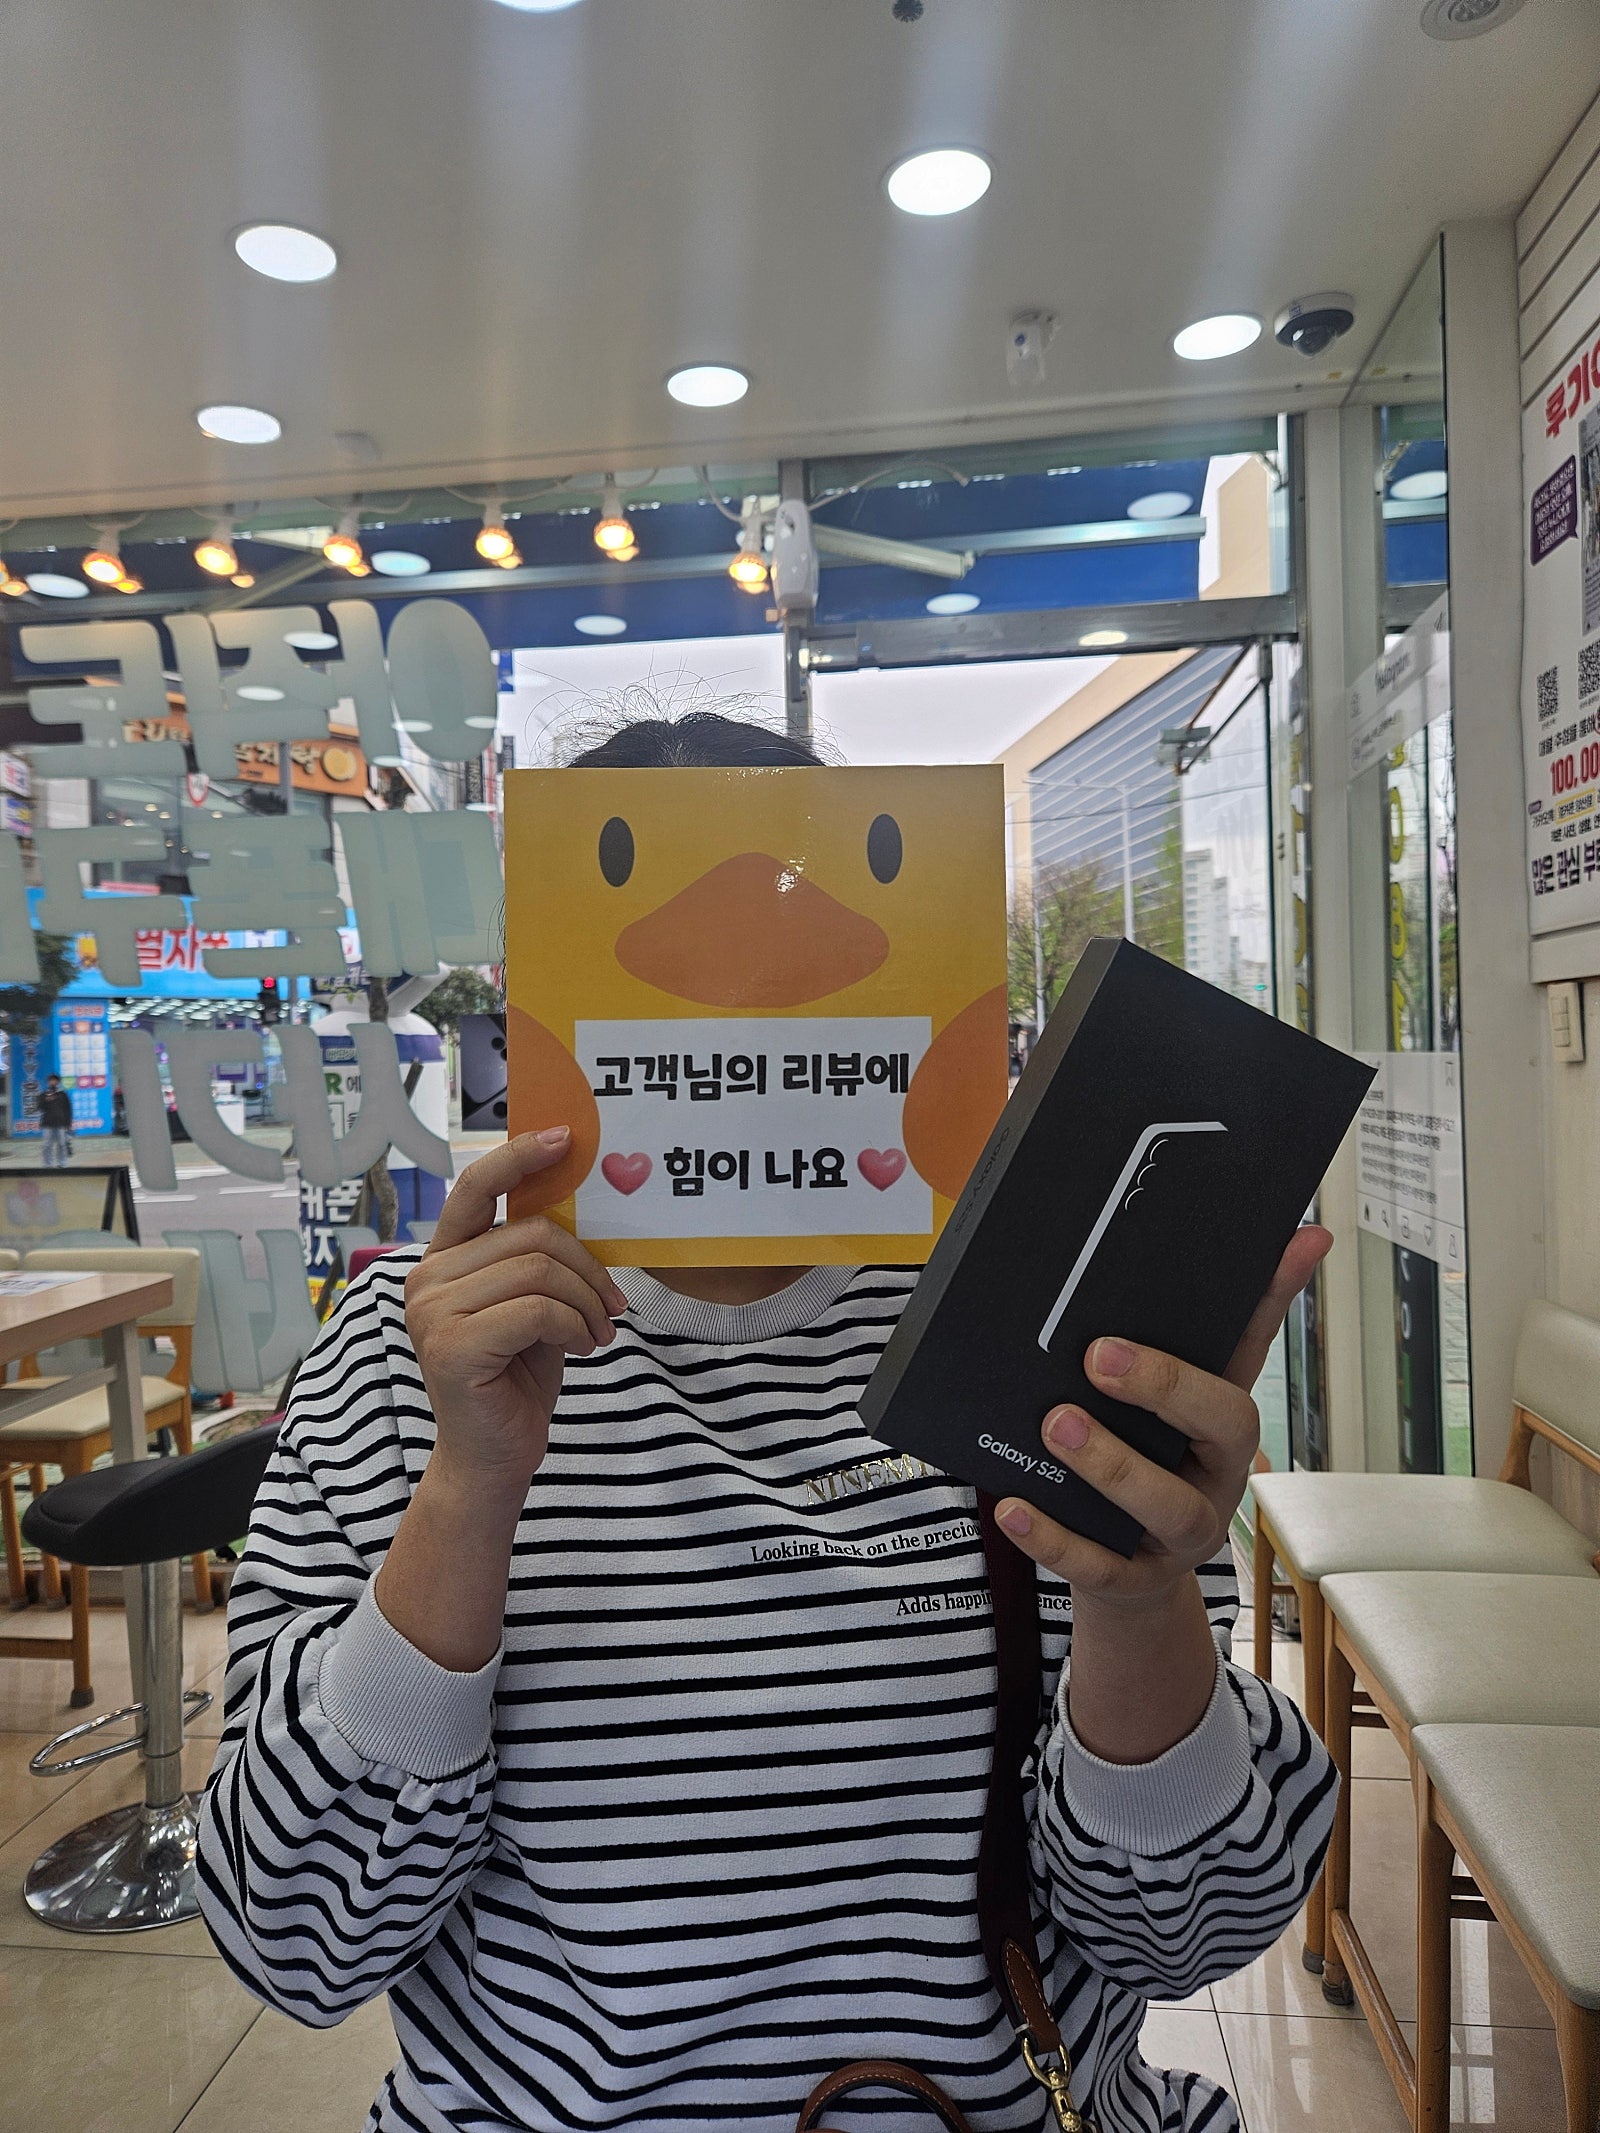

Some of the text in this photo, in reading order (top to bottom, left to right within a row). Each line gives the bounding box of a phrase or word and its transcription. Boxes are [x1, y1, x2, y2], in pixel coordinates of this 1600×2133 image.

[1550, 741, 1600, 796] 100,00
[1532, 854, 1555, 896] 많은
[1556, 845, 1580, 889] 관심
[593, 1052, 909, 1101] 고객님의 리뷰에
[664, 1146, 848, 1196] 힘이 나요
[977, 1433, 1067, 1484] Galaxy S25
[751, 1540, 819, 1562] Looking
[824, 1541, 863, 1556] back
[866, 1542, 887, 1556] on
[890, 1534, 920, 1551] the
[896, 1598, 941, 1616] Adds
